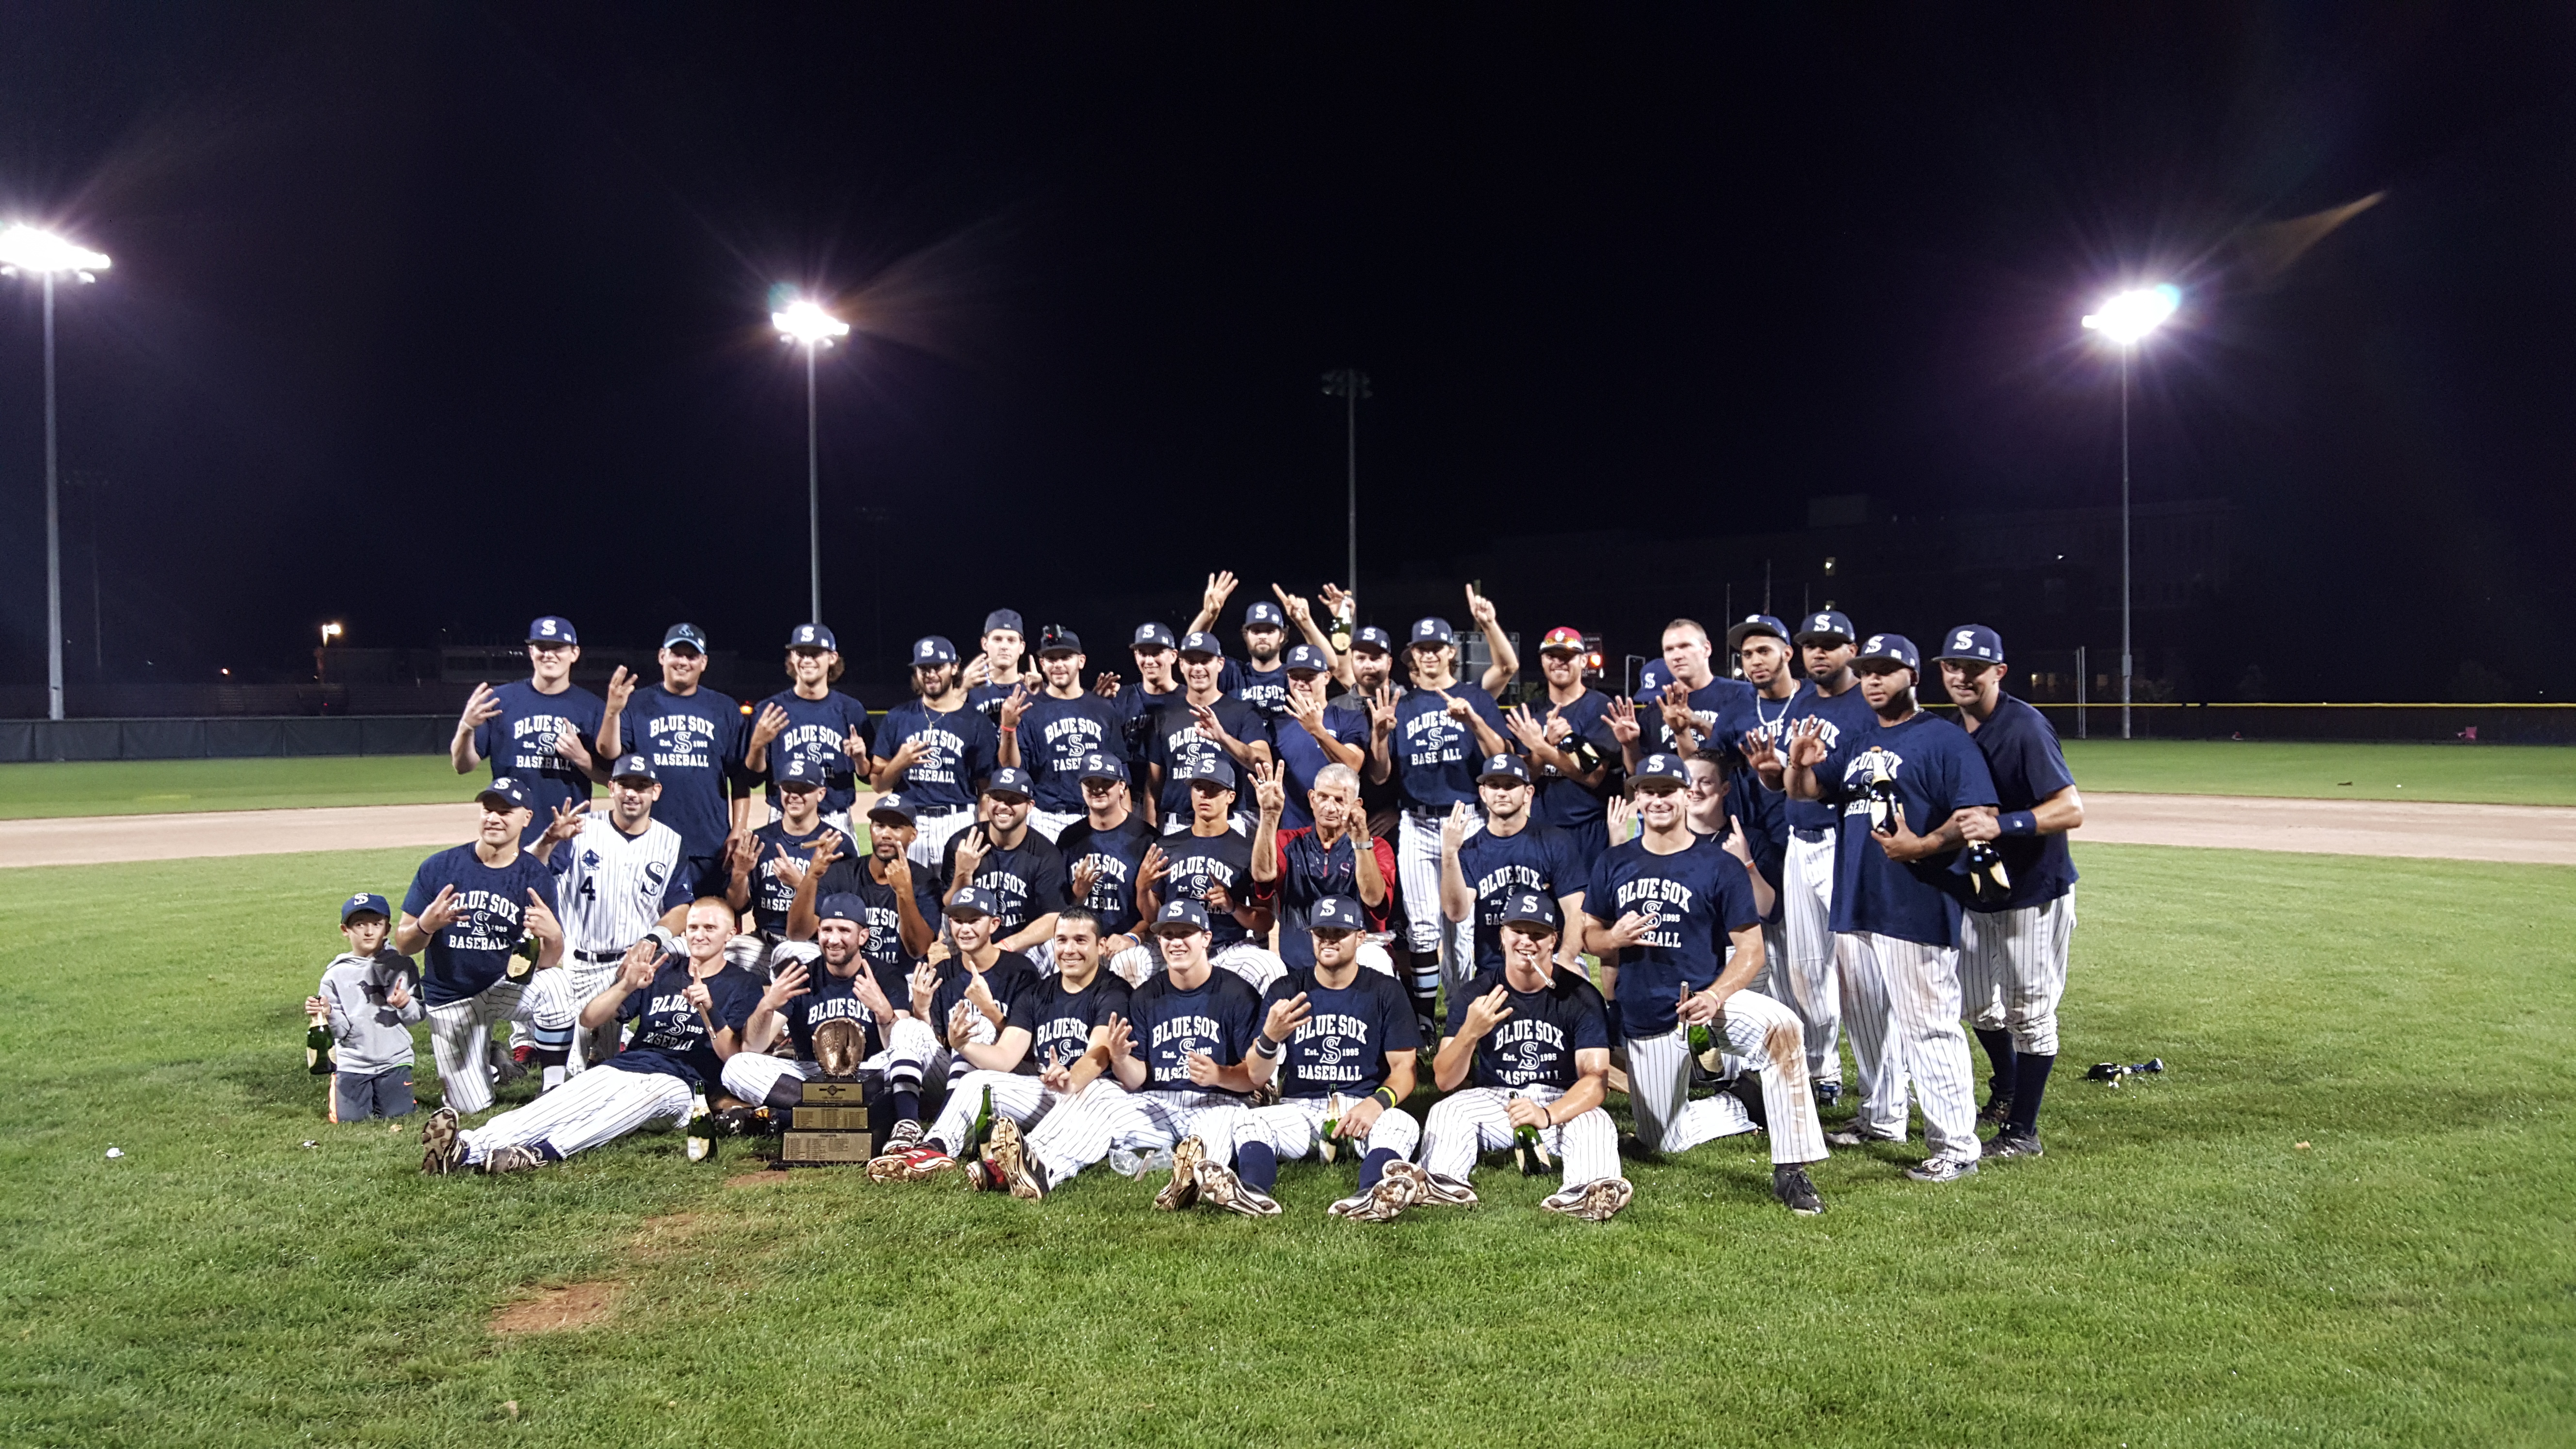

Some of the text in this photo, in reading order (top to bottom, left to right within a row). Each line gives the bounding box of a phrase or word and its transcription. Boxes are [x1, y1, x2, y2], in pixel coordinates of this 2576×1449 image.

[1255, 605, 1268, 619] S
[541, 620, 556, 635] S
[1420, 620, 1434, 635] S
[1814, 614, 1832, 632] S
[801, 627, 814, 642] S
[1143, 625, 1155, 639] S
[1190, 632, 1203, 646] S
[1363, 628, 1376, 641] S
[1953, 630, 1976, 650] S
[921, 641, 934, 657] S
[1865, 636, 1885, 654] S
[1295, 646, 1308, 661] S
[1645, 673, 1655, 689] S
[514, 715, 552, 740] BLUE
[650, 715, 715, 741] BLUE SOX
[1045, 717, 1102, 744] BLUE SOX
[1407, 711, 1438, 740] BLUE
[784, 725, 843, 753] BLUE SOX
[940, 733, 965, 758] SOX
[516, 756, 571, 772] BASEBALL
[630, 756, 645, 771] S
[654, 753, 709, 768] BASEBALL
[789, 760, 805, 776] S
[1089, 755, 1103, 771] S
[1200, 759, 1216, 773] S
[1492, 755, 1507, 770] S
[1646, 755, 1665, 773] S
[908, 768, 956, 784] BASEBALL
[999, 768, 1016, 784] S
[1173, 767, 1193, 780] BASE
[494, 777, 511, 790] S
[885, 793, 901, 807] S
[1102, 855, 1127, 883] SOX
[1169, 856, 1234, 888] BLUE SOX
[580, 875, 596, 902] 4
[765, 883, 777, 891] Est.
[1003, 872, 1028, 899] SOX
[1479, 865, 1542, 900] BLUE SOX
[354, 892, 370, 906] S
[958, 887, 976, 903] S
[1617, 878, 1692, 913] BLUE SOX
[490, 893, 520, 925] SOX
[1167, 901, 1184, 918] S
[1320, 898, 1337, 917] S
[1521, 895, 1538, 913] S
[1343, 913, 1353, 924] DA
[1662, 914, 1680, 922] 1995
[449, 934, 511, 951] BASEBALL
[649, 995, 689, 1016] BLUE
[807, 998, 872, 1025] BLUE SOX
[686, 1024, 704, 1035] 1995
[1037, 1017, 1090, 1047] BLUE SOX
[1152, 1015, 1220, 1048] BLUE SOX
[1294, 1014, 1368, 1045] BLUE SOX
[1494, 1019, 1565, 1051] BLUE SOX
[643, 1031, 694, 1051] BASEBALL
[1162, 1050, 1177, 1059] Est.
[1196, 1046, 1212, 1055] 1995
[1304, 1047, 1319, 1056] Est.
[1342, 1048, 1359, 1056] 1995
[1502, 1052, 1518, 1062] Est.
[1540, 1053, 1557, 1061] 1995
[1297, 1064, 1363, 1081] BASEBALL
